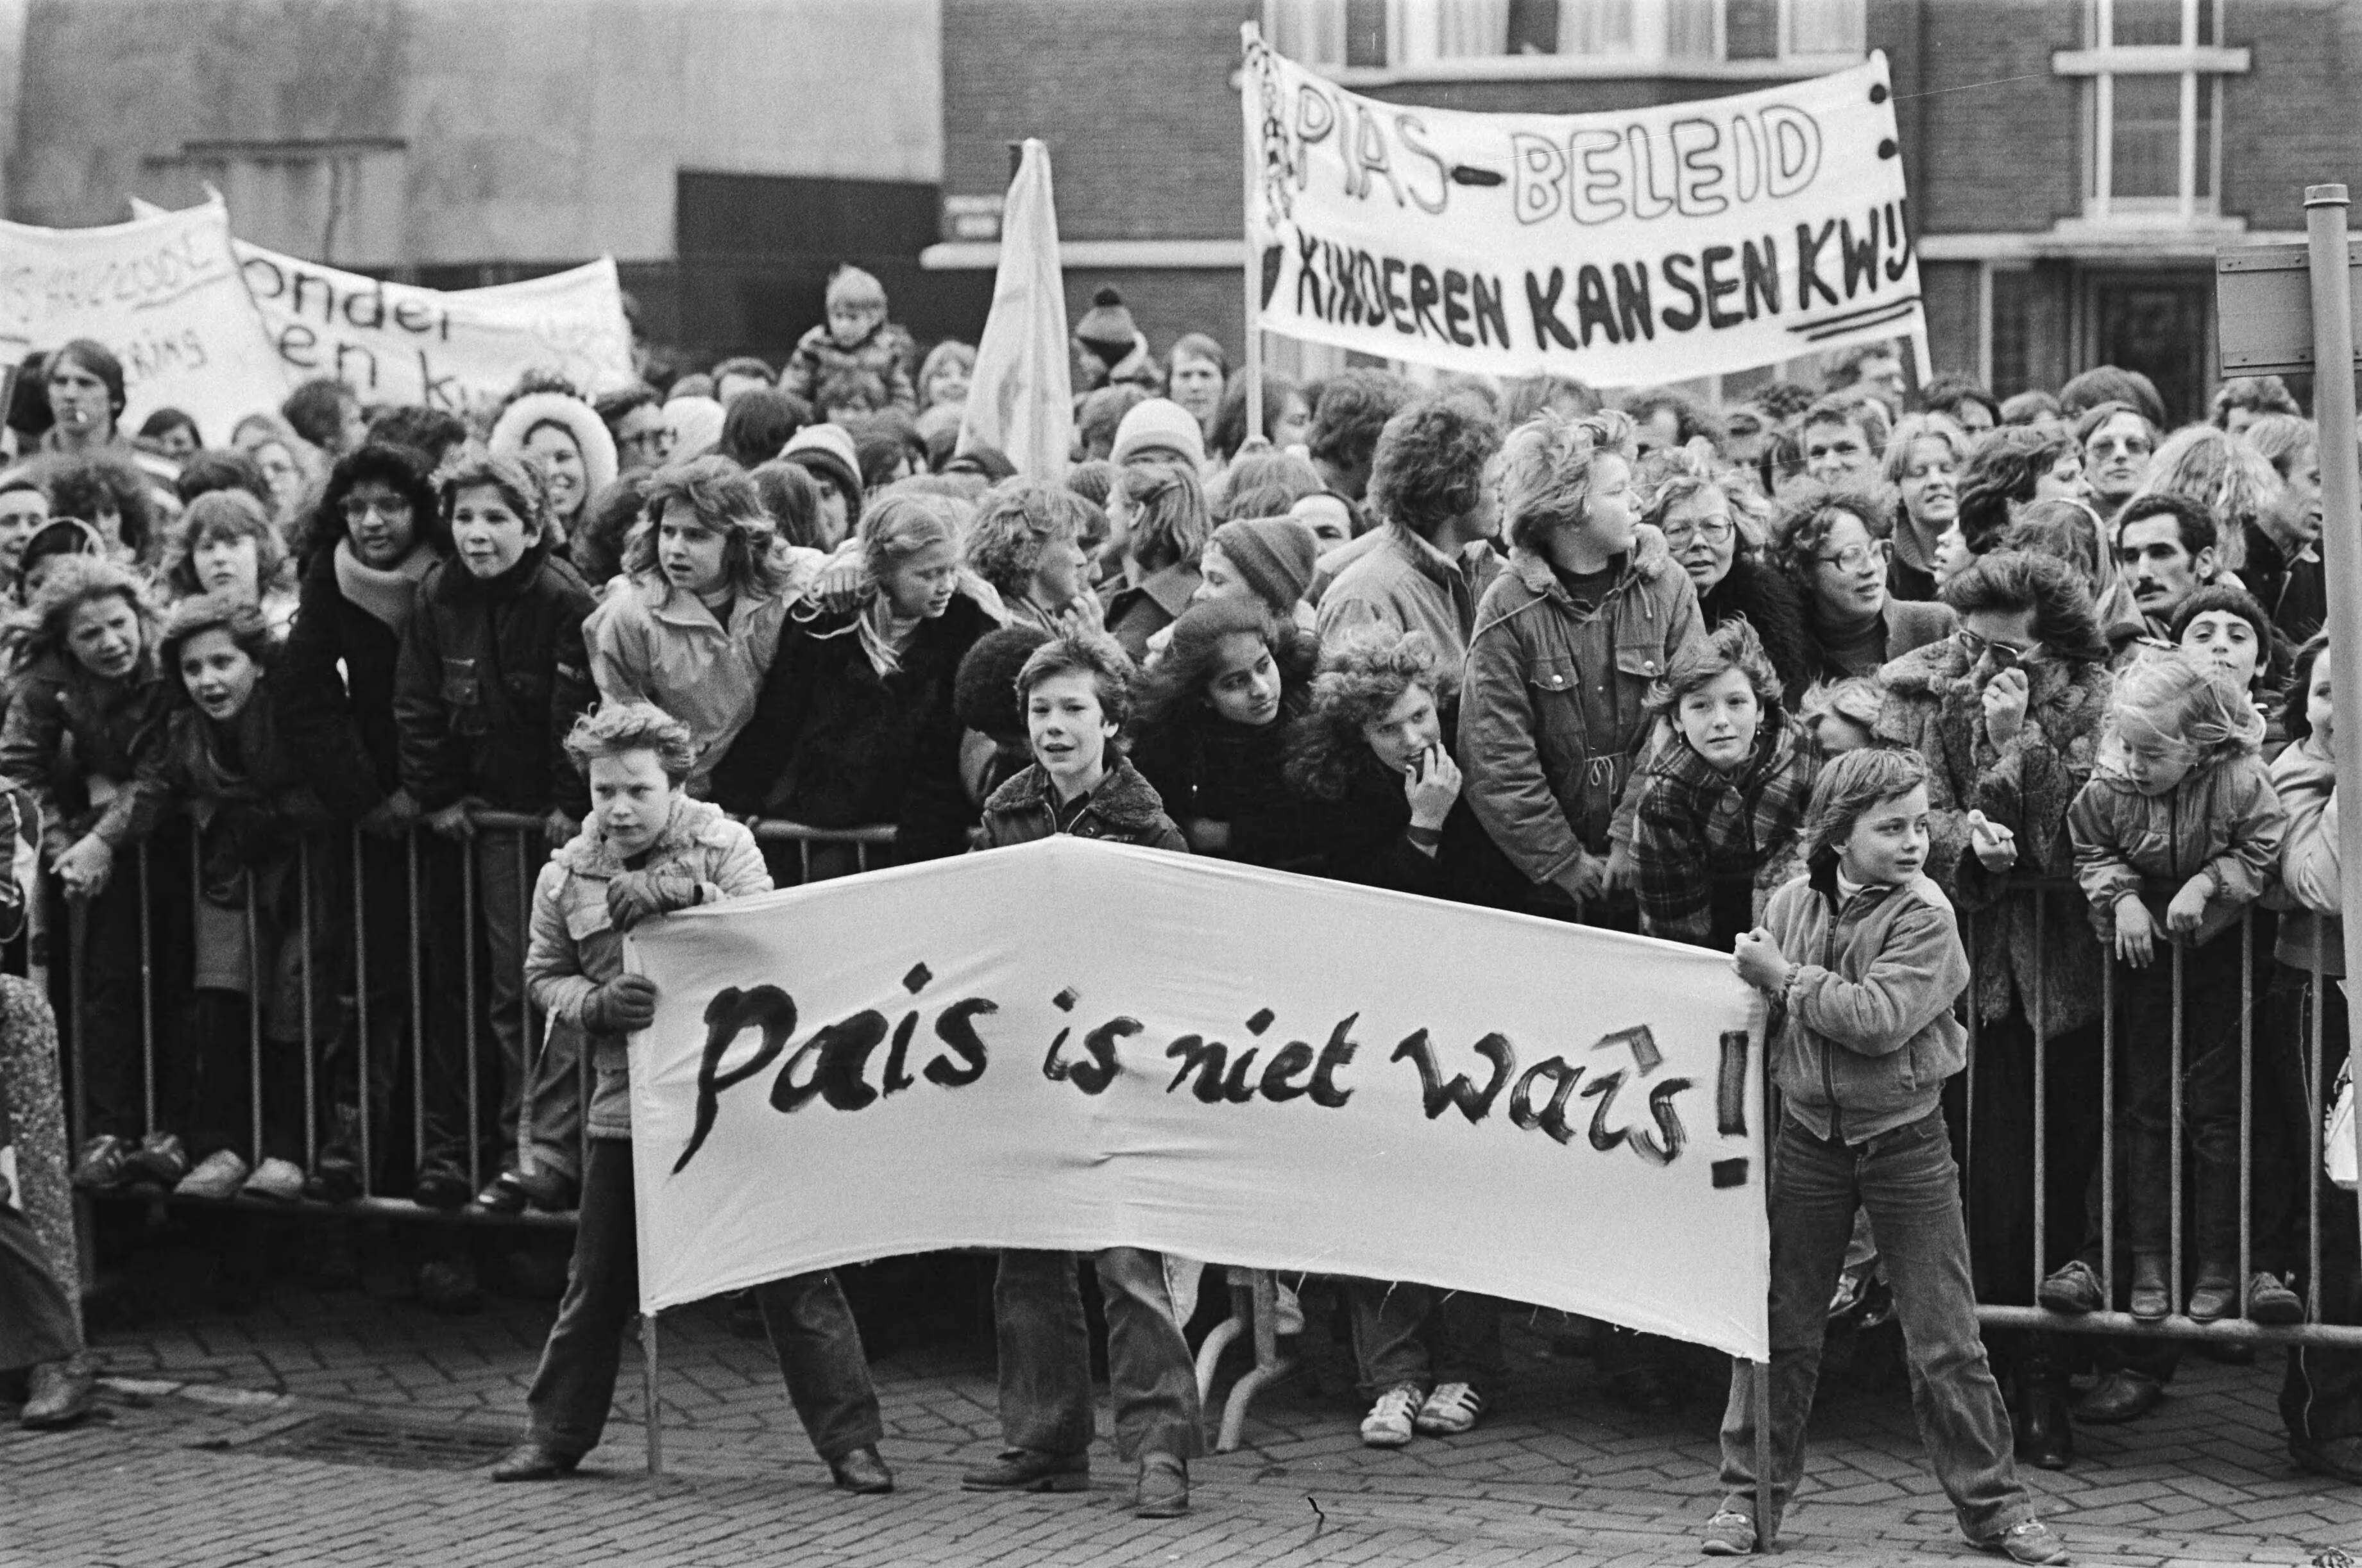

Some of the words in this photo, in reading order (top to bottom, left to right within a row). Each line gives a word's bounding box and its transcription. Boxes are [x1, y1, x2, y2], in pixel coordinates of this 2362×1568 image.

[1524, 233, 1781, 353] KANSEN
[1041, 985, 1144, 1097] is
[1165, 1007, 1360, 1110] niet
